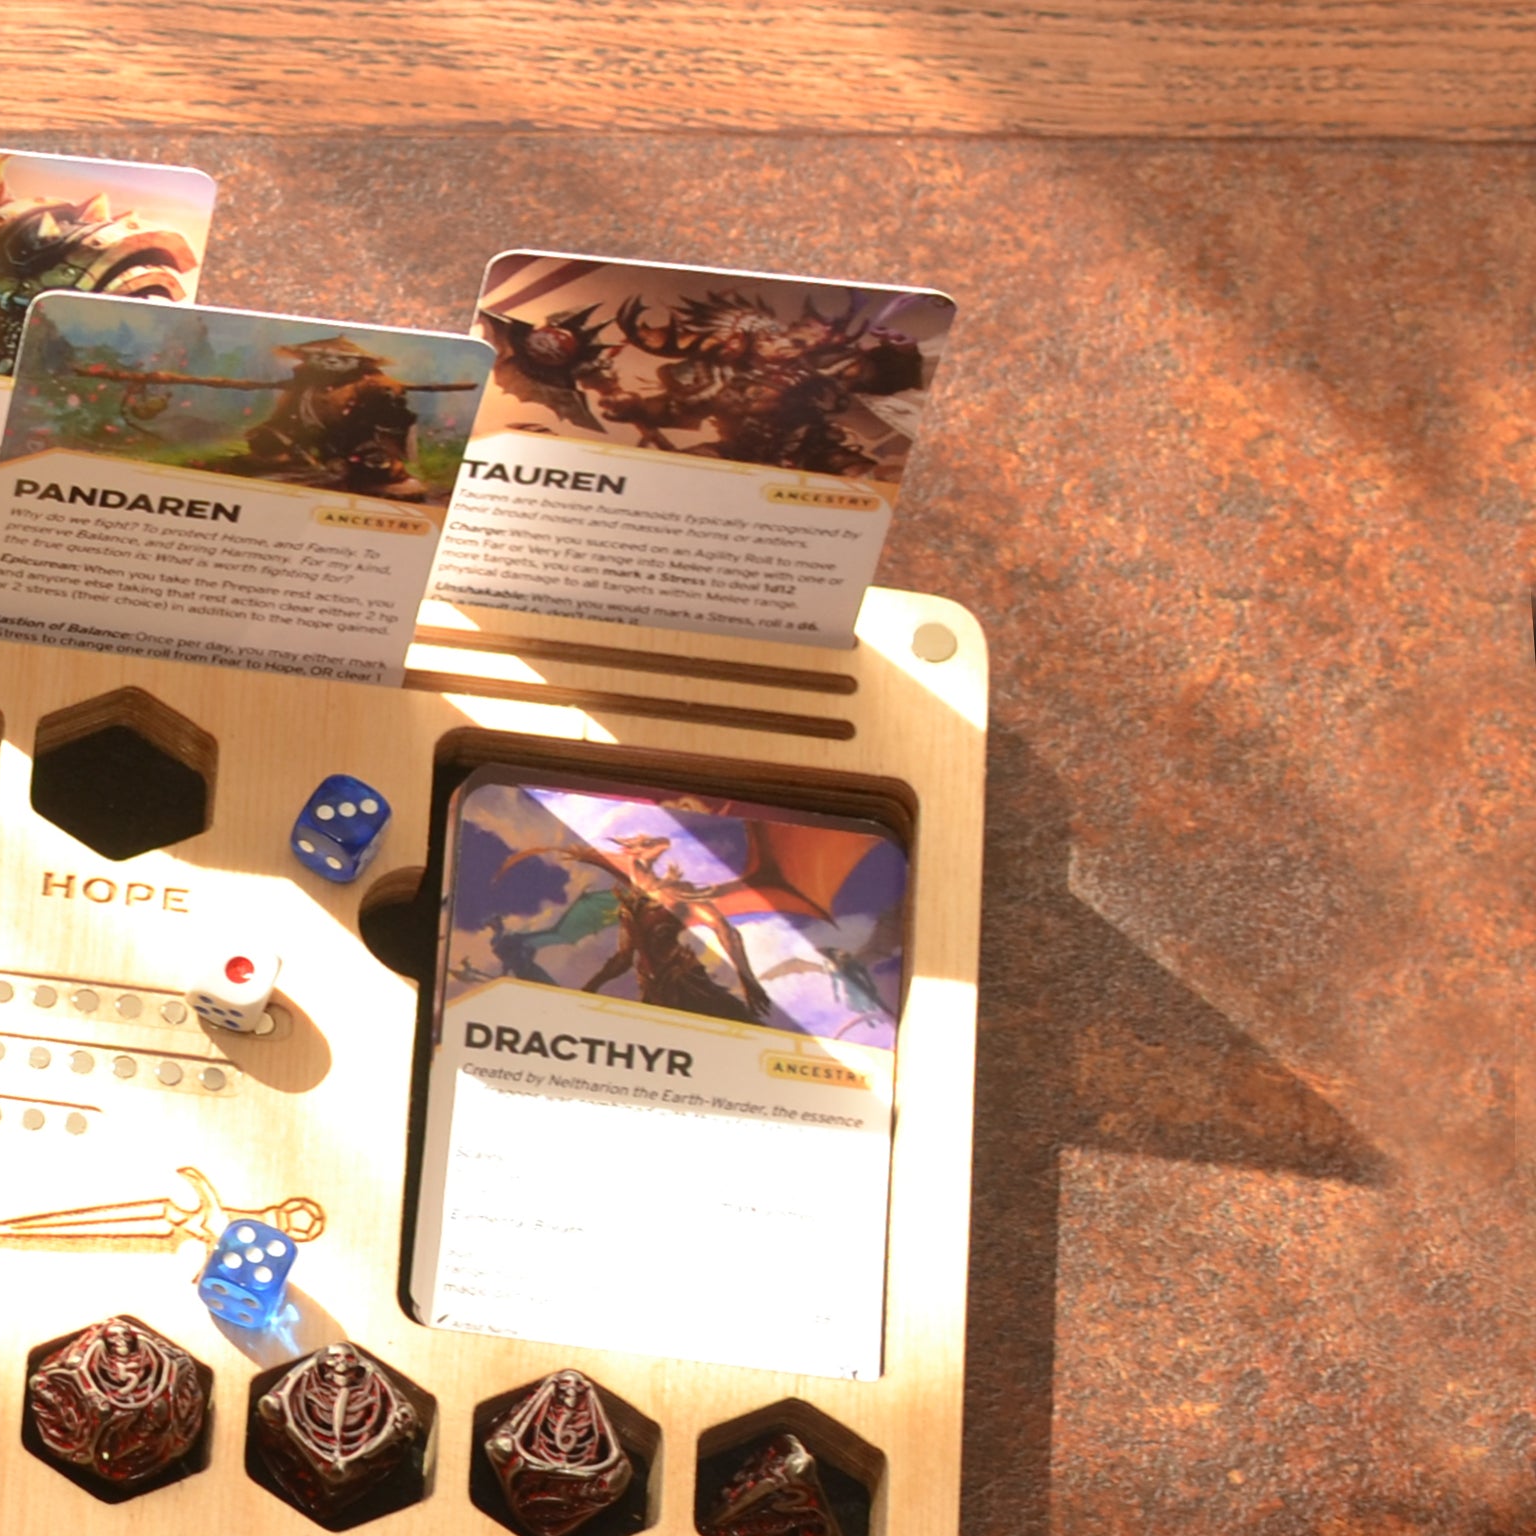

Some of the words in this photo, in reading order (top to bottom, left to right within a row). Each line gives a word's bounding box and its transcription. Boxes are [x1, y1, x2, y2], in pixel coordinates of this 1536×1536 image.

[461, 458, 626, 494] TAUREN
[13, 479, 241, 522] PANDAREN
[772, 490, 871, 506] ANCESTRY
[323, 513, 419, 530] ANCESTRY
[41, 871, 190, 913] HOPE
[464, 1022, 693, 1076] DRACTHYR
[462, 1062, 524, 1082] Created
[525, 1071, 546, 1086] by
[632, 1085, 659, 1100] the
[771, 1104, 799, 1120] the
[799, 1110, 865, 1128] essence
